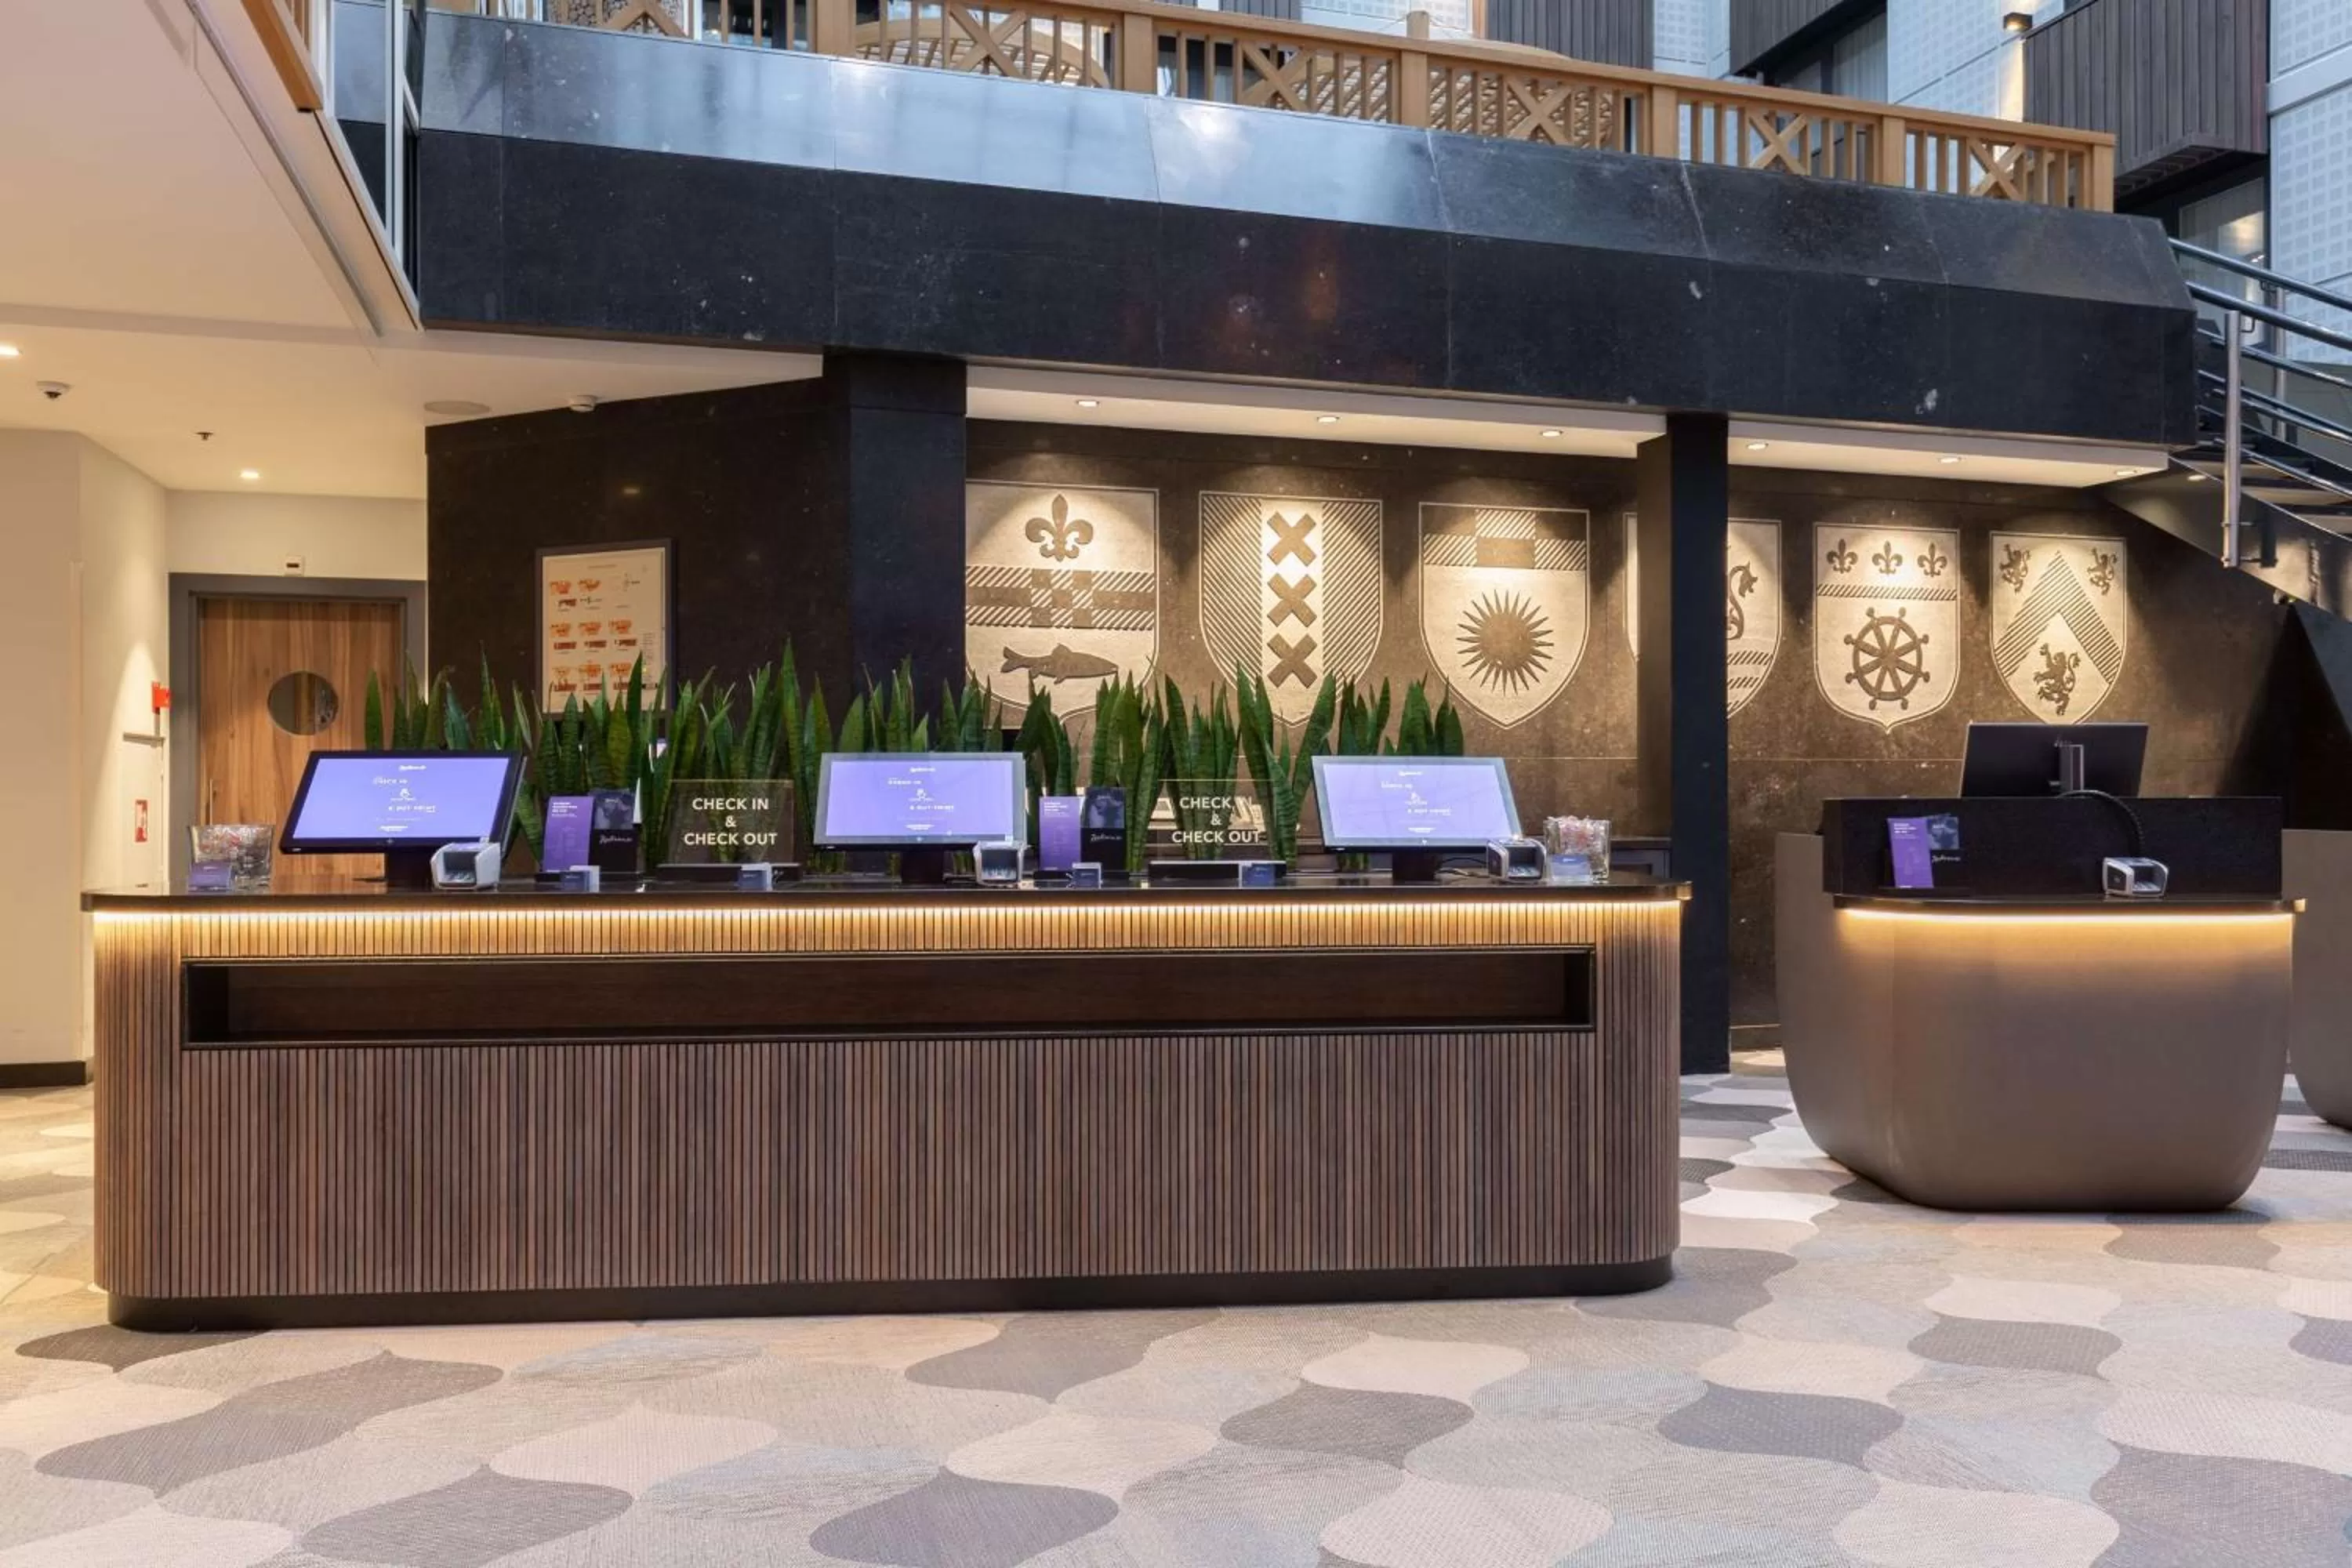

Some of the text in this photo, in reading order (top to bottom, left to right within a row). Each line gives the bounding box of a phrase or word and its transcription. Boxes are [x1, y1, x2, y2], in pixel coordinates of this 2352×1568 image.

[692, 798, 768, 810] CHECK IN
[1179, 797, 1252, 808] CHECK N
[725, 815, 737, 827] &
[1210, 813, 1222, 826] &
[684, 833, 778, 845] CHECK OUT
[1172, 831, 1261, 843] CHECK OUT
